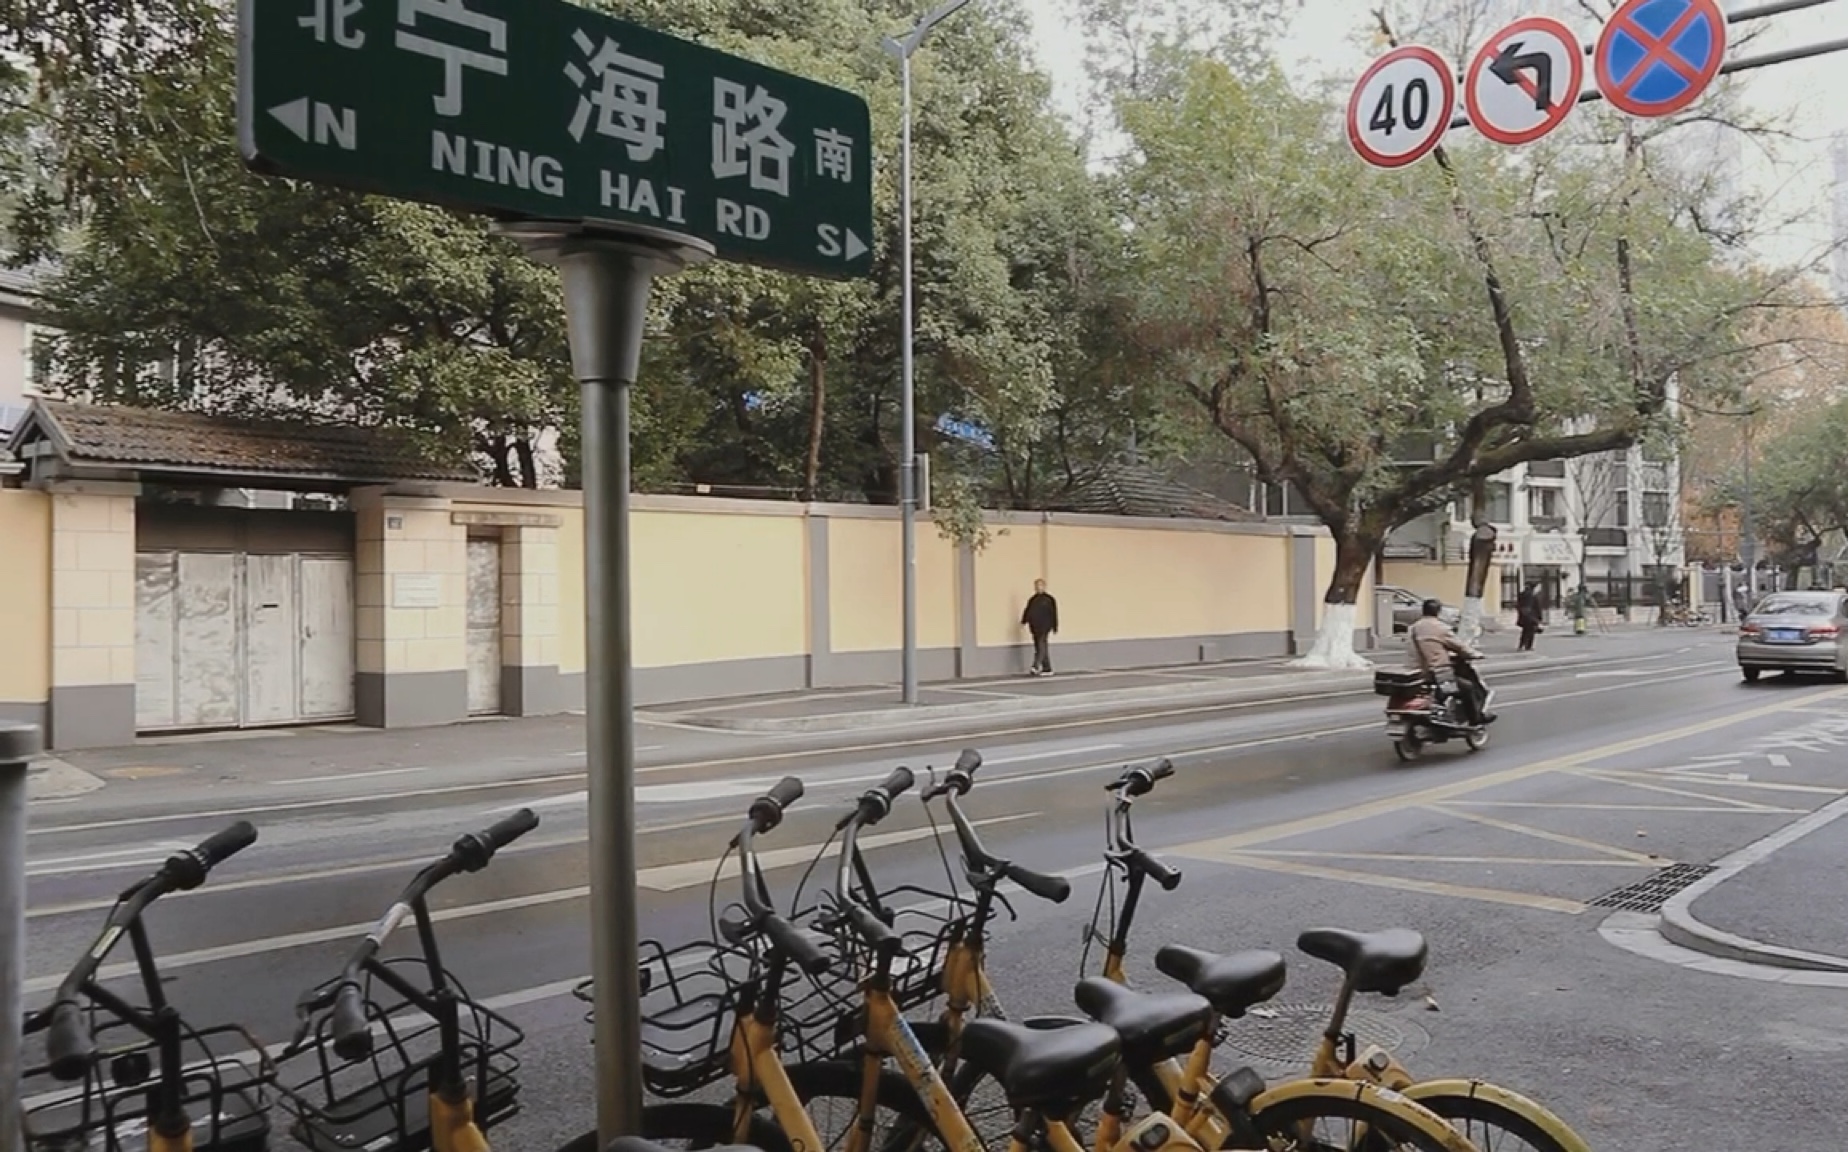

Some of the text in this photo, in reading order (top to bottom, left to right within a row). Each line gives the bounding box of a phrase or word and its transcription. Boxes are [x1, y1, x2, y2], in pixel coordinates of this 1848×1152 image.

[315, 102, 357, 151] N
[396, 0, 796, 197] 宁海路
[1369, 77, 1430, 137] 40
[813, 127, 854, 183] 南
[432, 130, 771, 241] NING HAI RD
[817, 223, 842, 257] S
